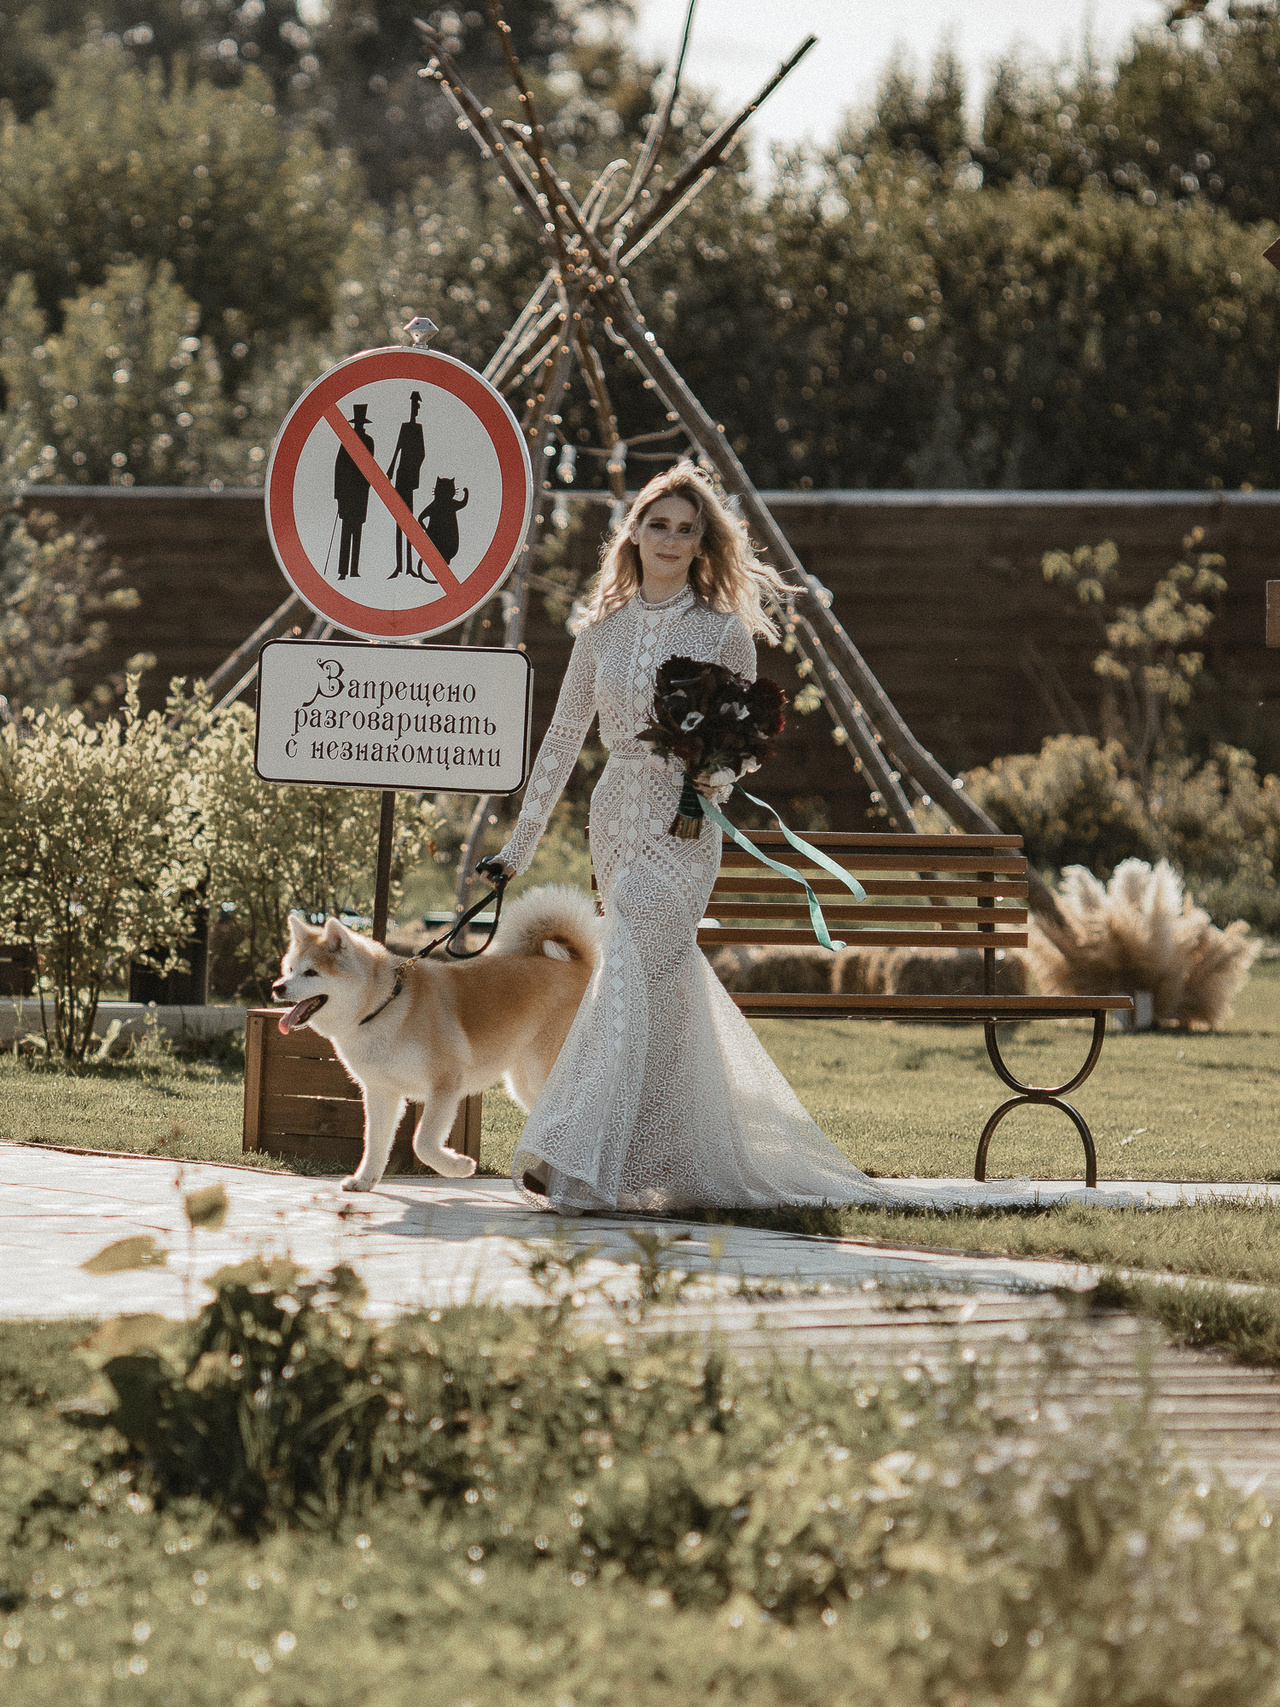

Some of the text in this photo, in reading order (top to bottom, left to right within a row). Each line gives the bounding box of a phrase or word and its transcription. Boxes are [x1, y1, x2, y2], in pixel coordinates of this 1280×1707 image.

[301, 657, 477, 710] Запрещено
[290, 707, 497, 742] разговаривать
[284, 738, 501, 771] с незнакомцами
